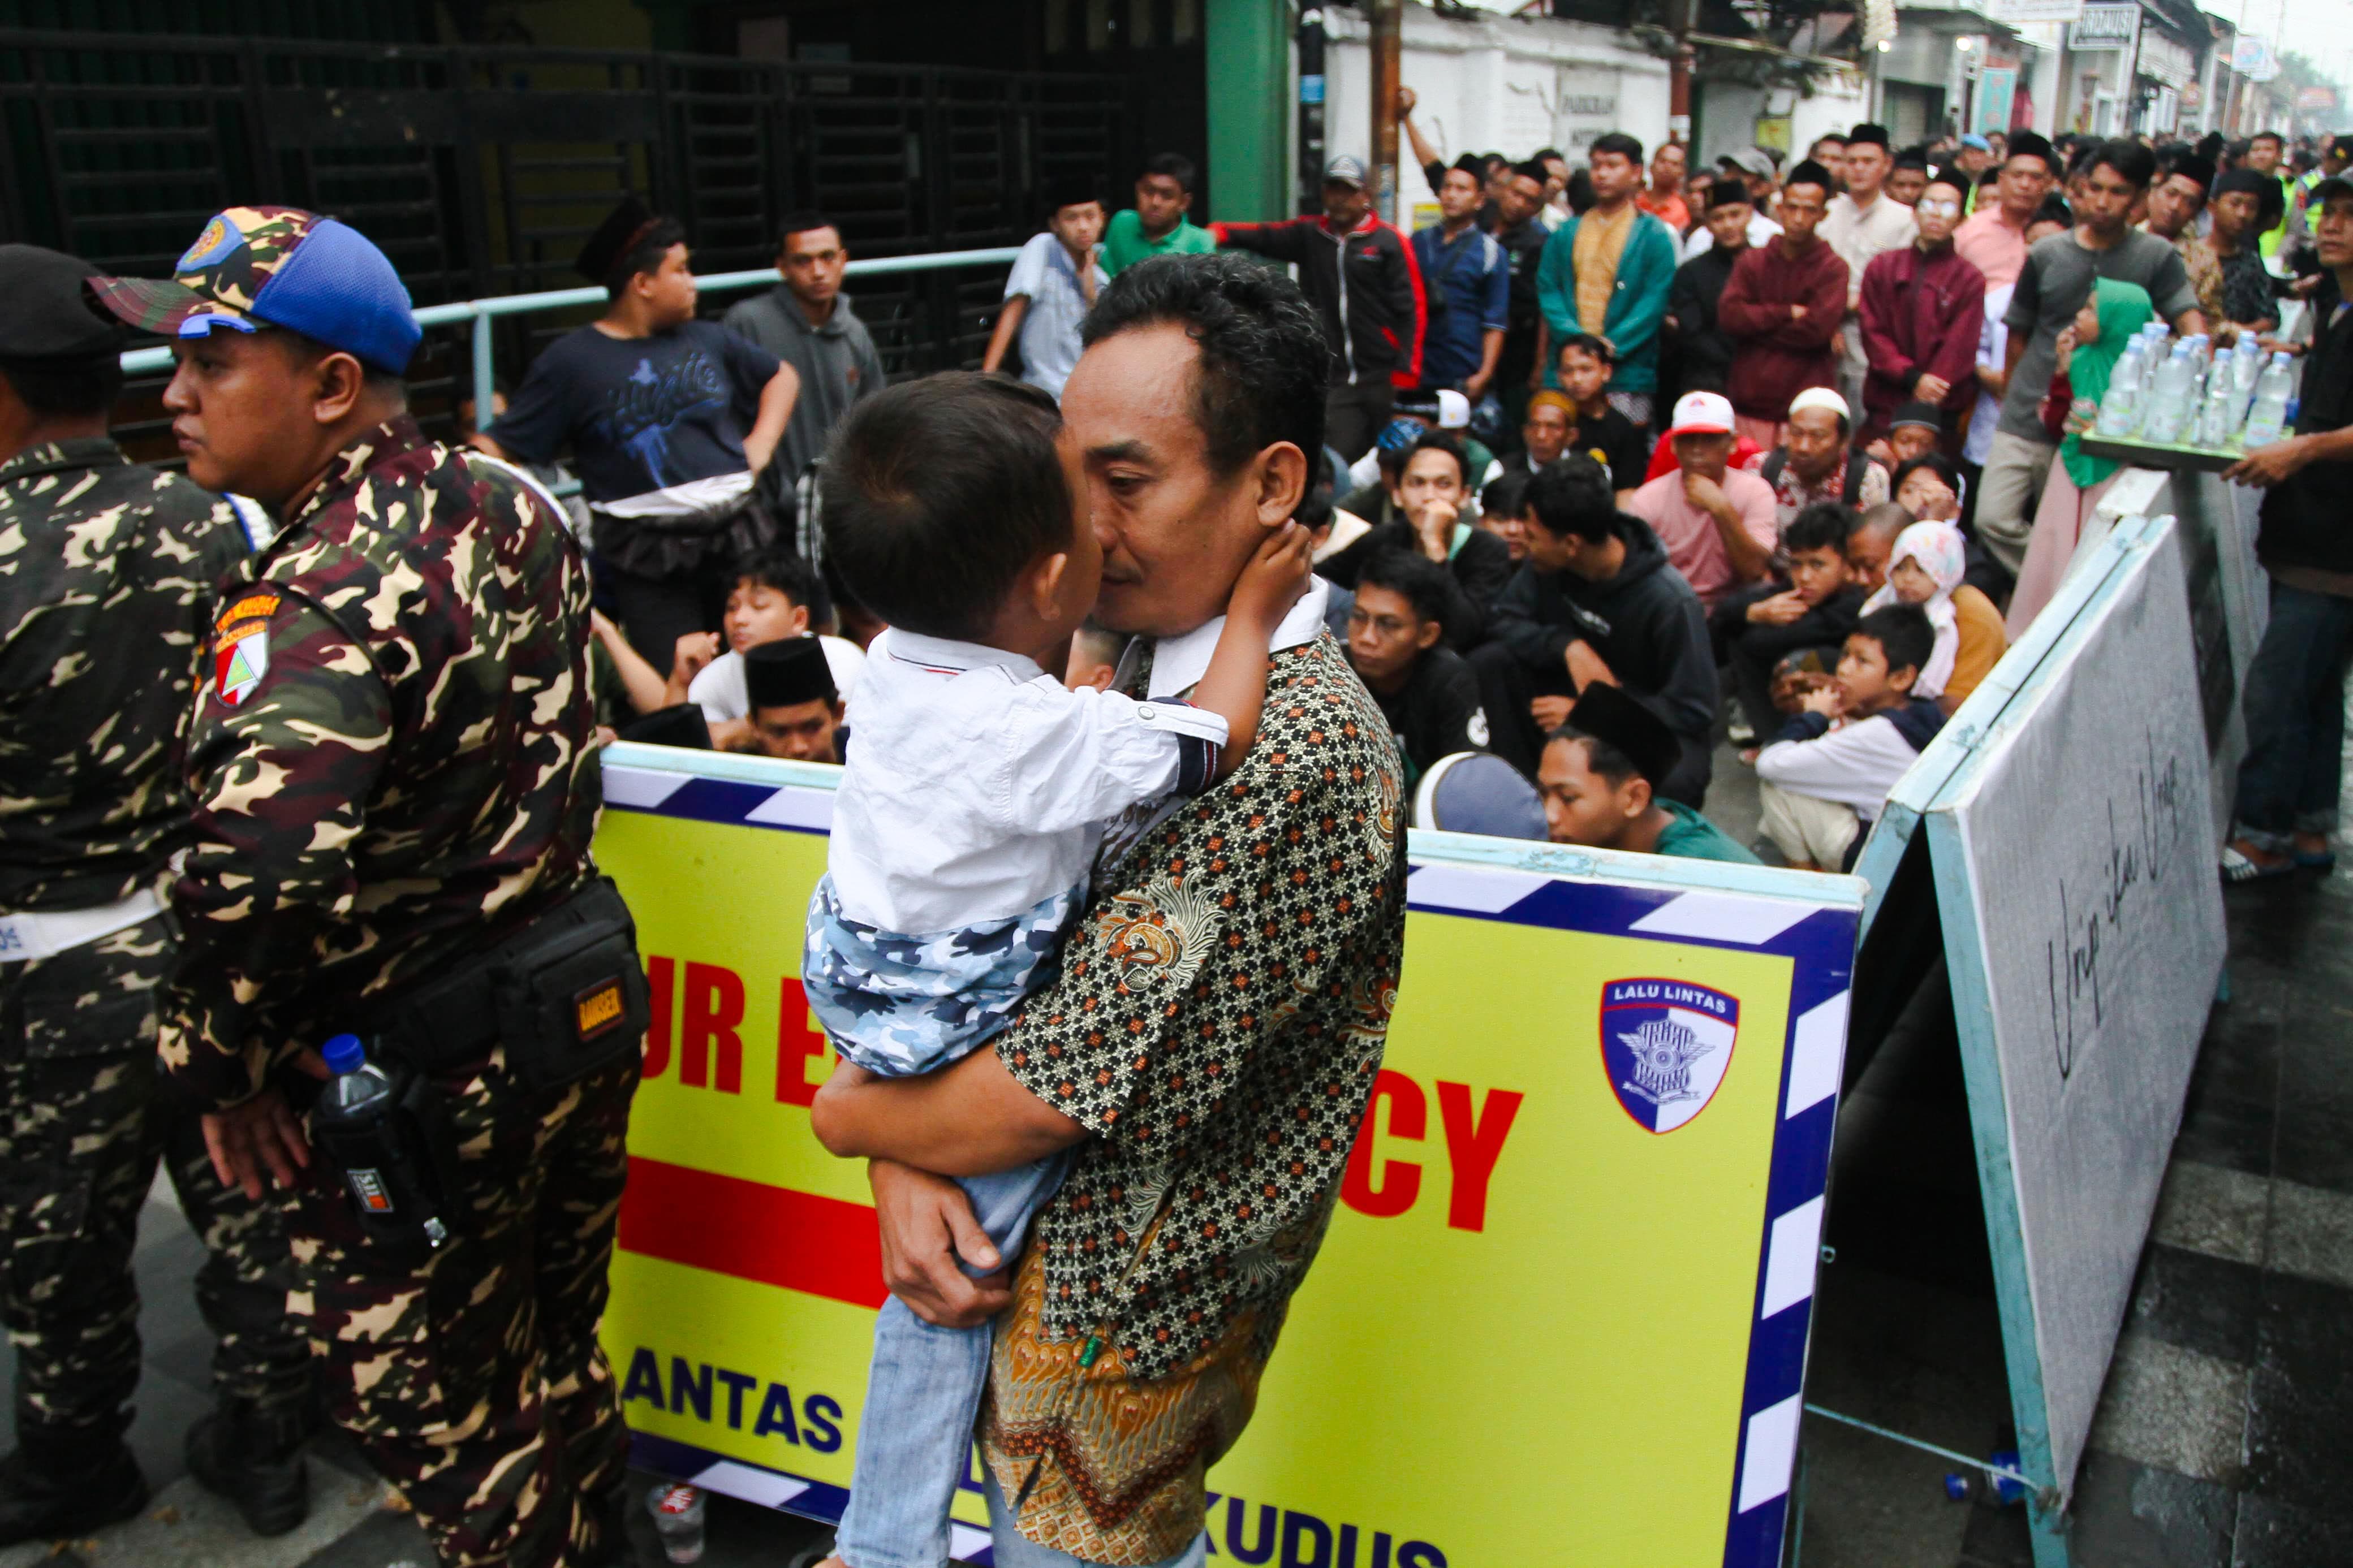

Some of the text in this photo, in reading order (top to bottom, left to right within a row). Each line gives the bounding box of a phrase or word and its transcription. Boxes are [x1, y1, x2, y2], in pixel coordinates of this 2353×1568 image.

[1614, 984, 1726, 1014] LALU LINTAS
[1339, 1069, 1525, 1233] CY
